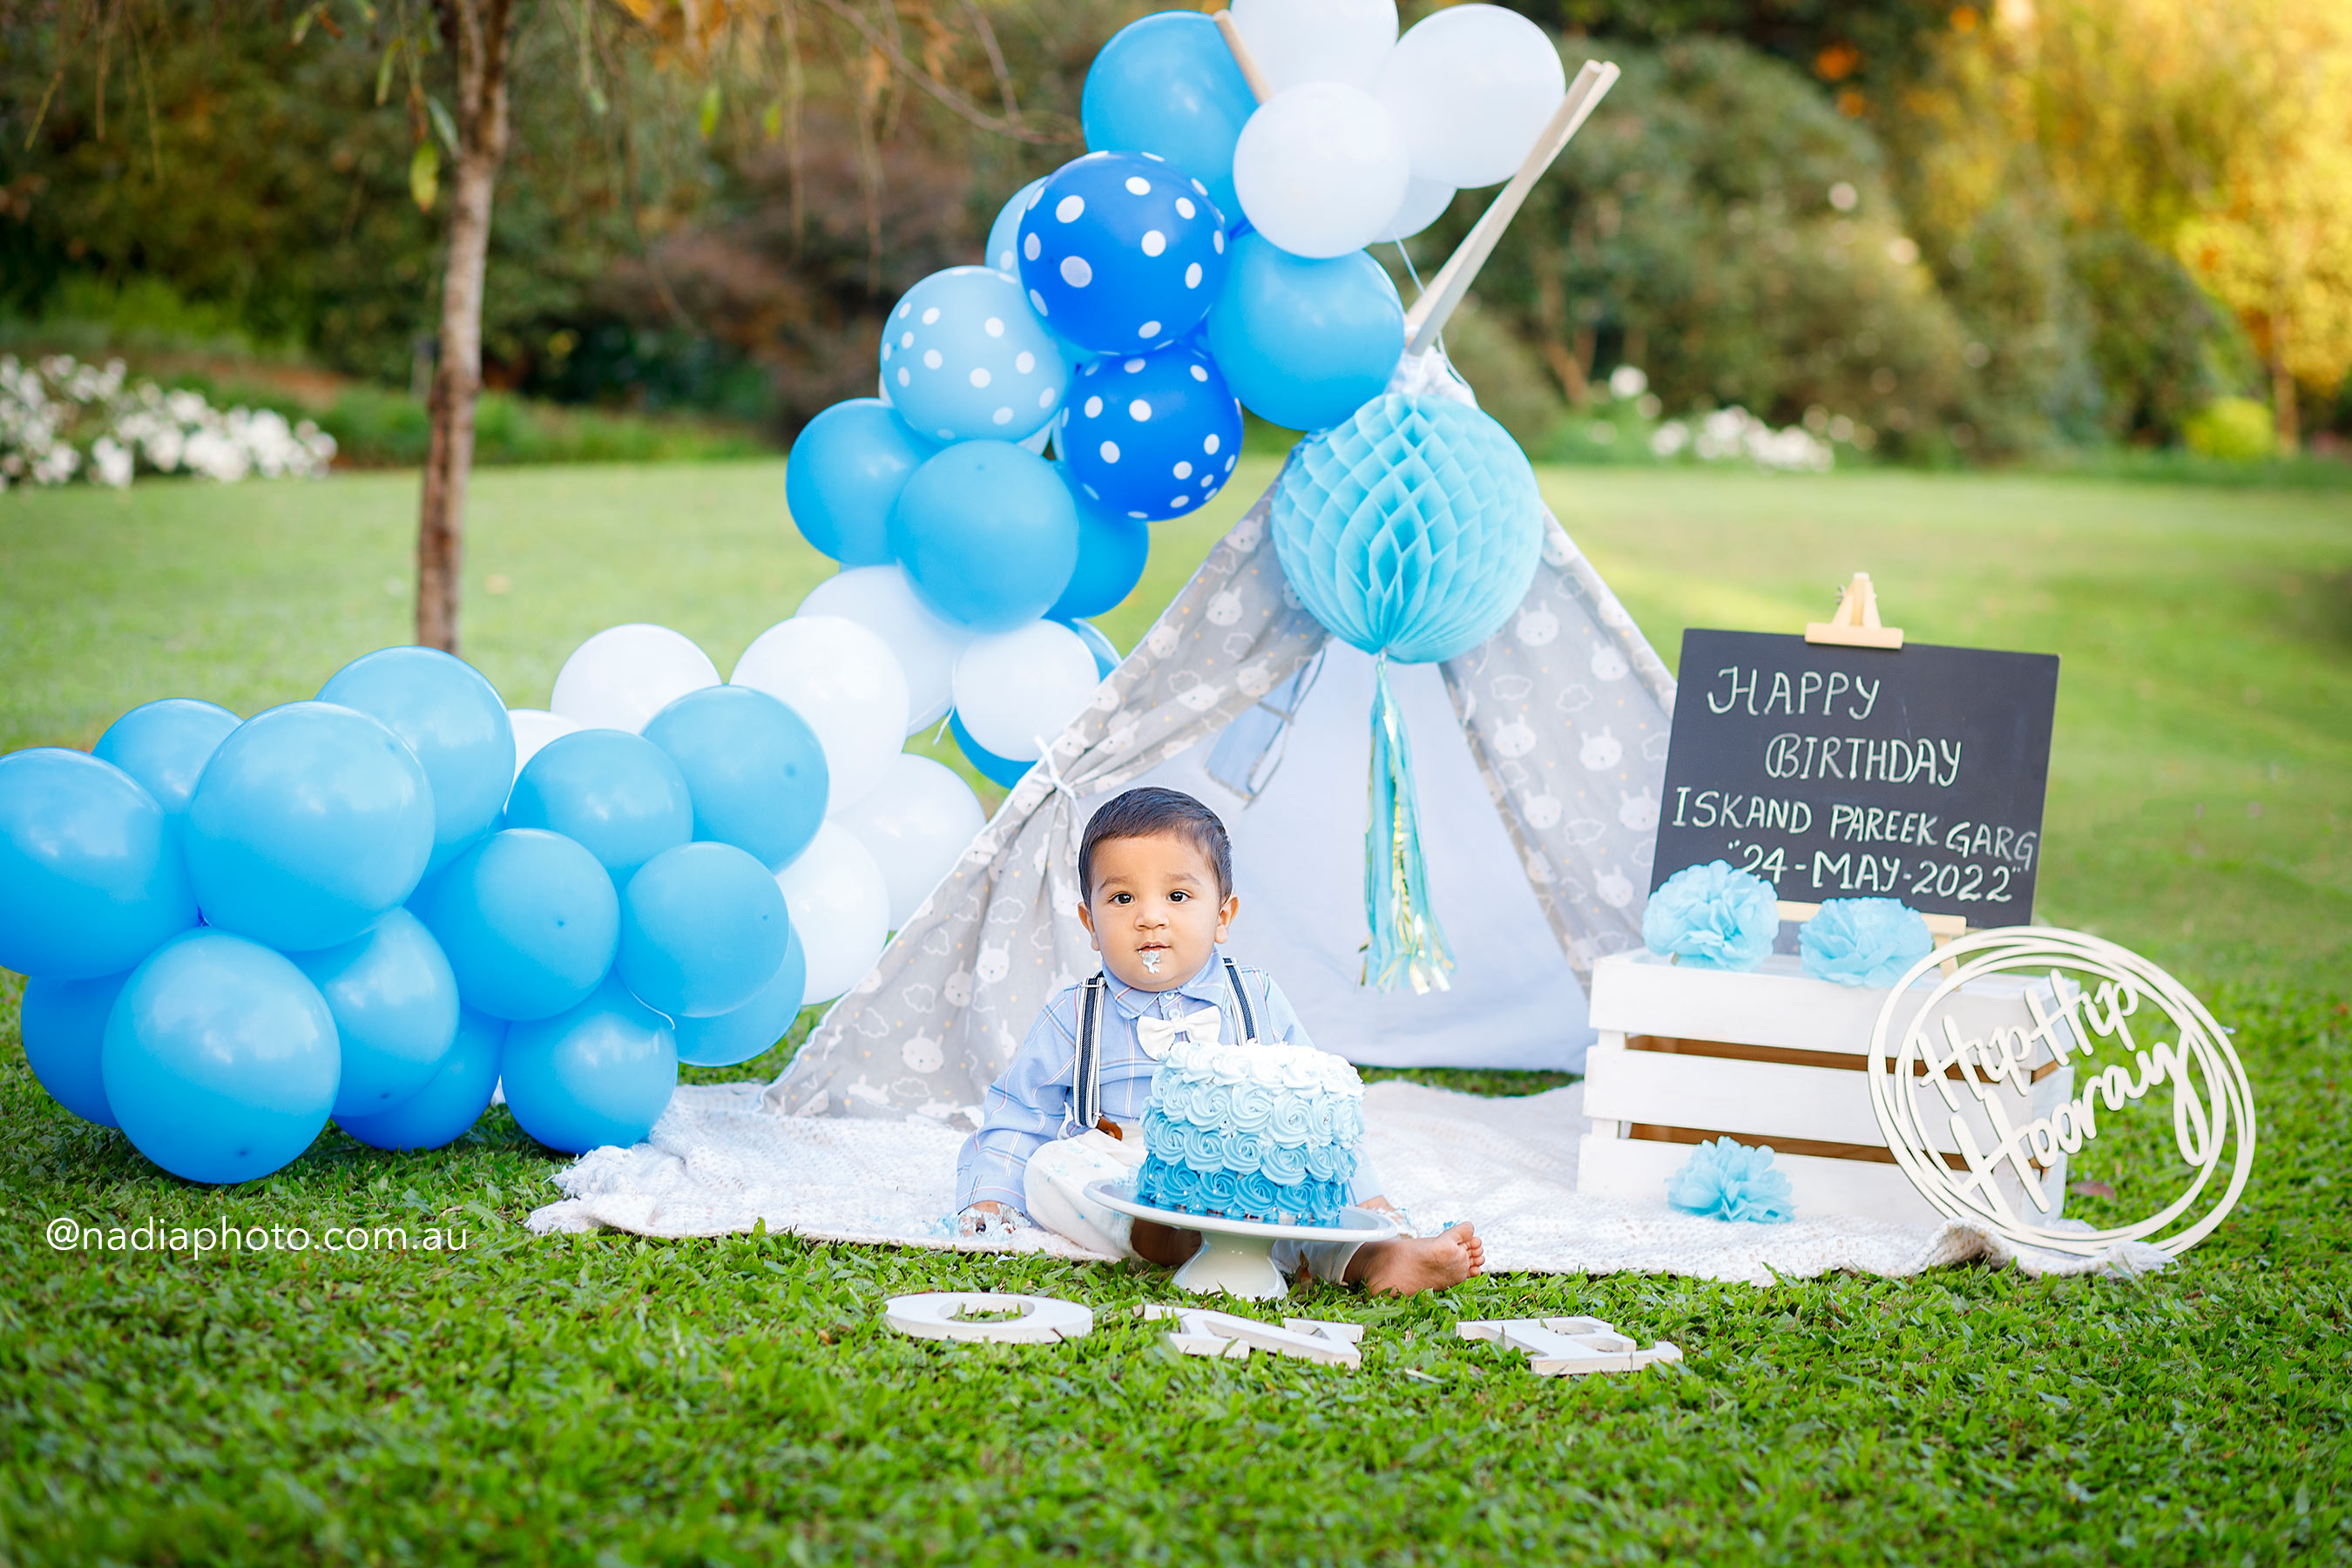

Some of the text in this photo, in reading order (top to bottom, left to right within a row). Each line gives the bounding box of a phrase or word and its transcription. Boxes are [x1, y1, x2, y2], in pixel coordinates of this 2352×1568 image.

[1707, 666, 1880, 720] HAPPY
[1765, 733, 1961, 786] BIRTHDAY
[1673, 787, 2037, 870] ISKAND PAREEK GARG
[1917, 969, 2139, 1112] Hip Hip
[1950, 1030, 2211, 1220] Hooray
